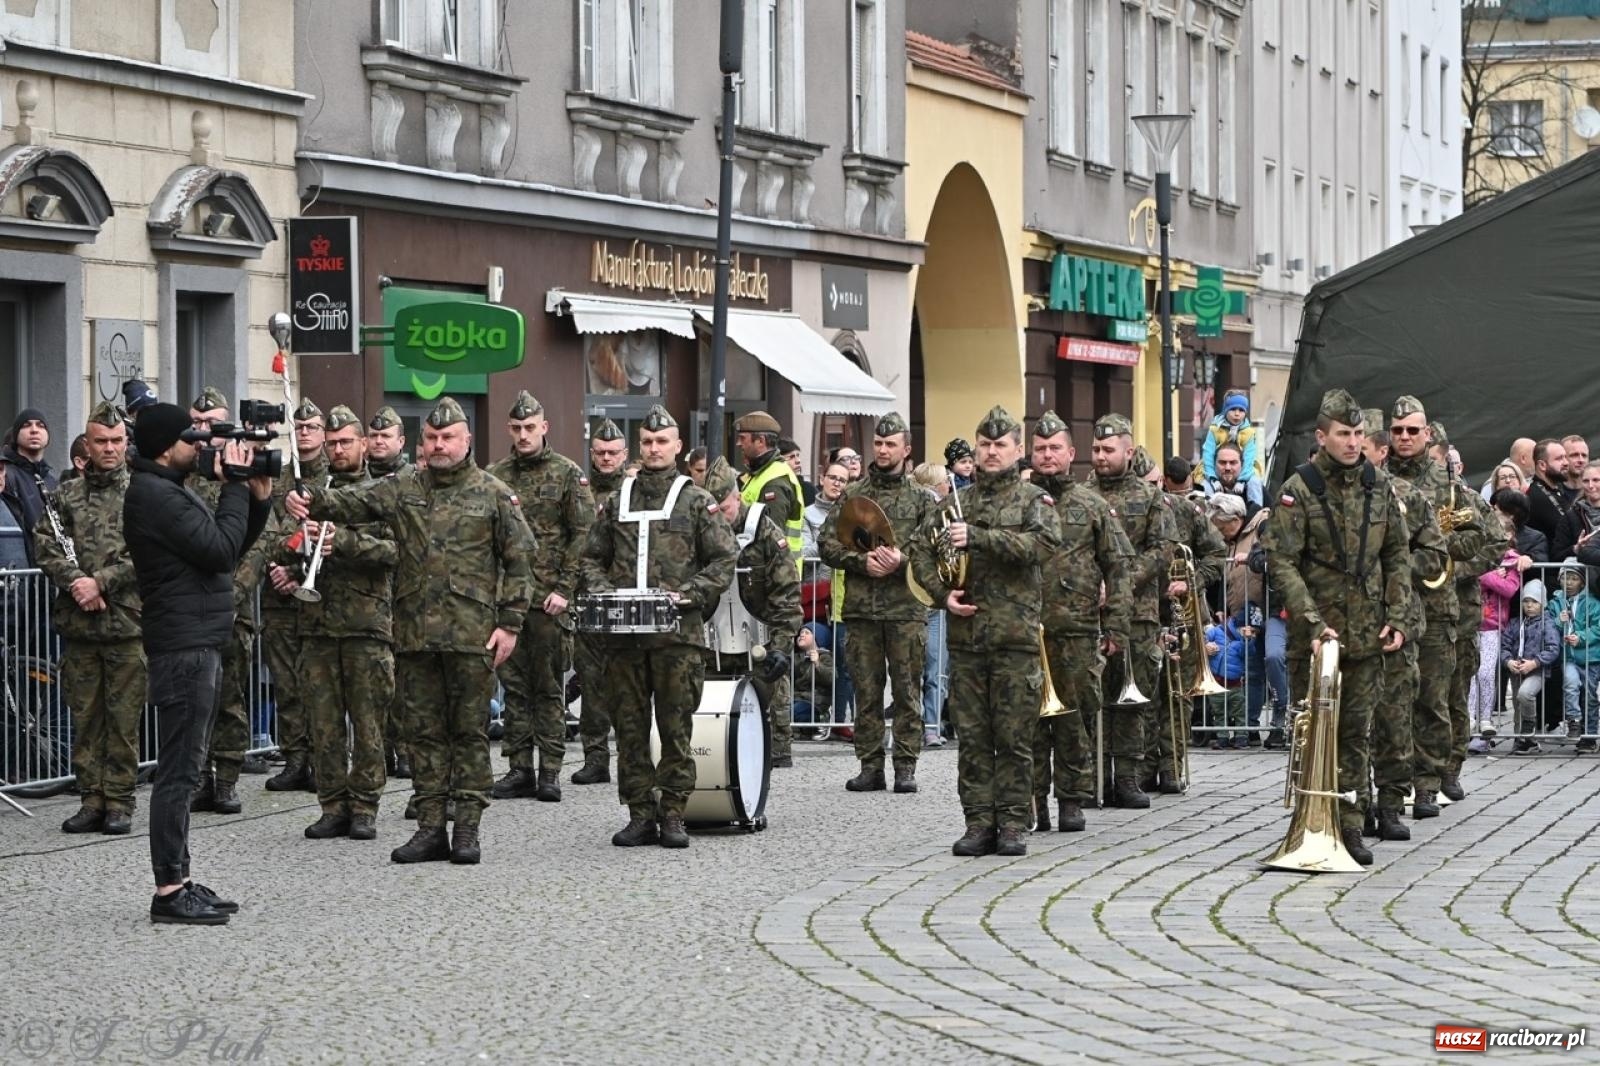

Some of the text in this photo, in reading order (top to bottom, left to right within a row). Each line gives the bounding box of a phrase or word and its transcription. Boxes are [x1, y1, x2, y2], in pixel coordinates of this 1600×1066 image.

[297, 257, 345, 272] TYSKIE
[591, 239, 675, 295] Manufaktura
[727, 251, 769, 304] ałeczka
[1049, 254, 1145, 320] APTEKA
[407, 318, 507, 349] żabka
